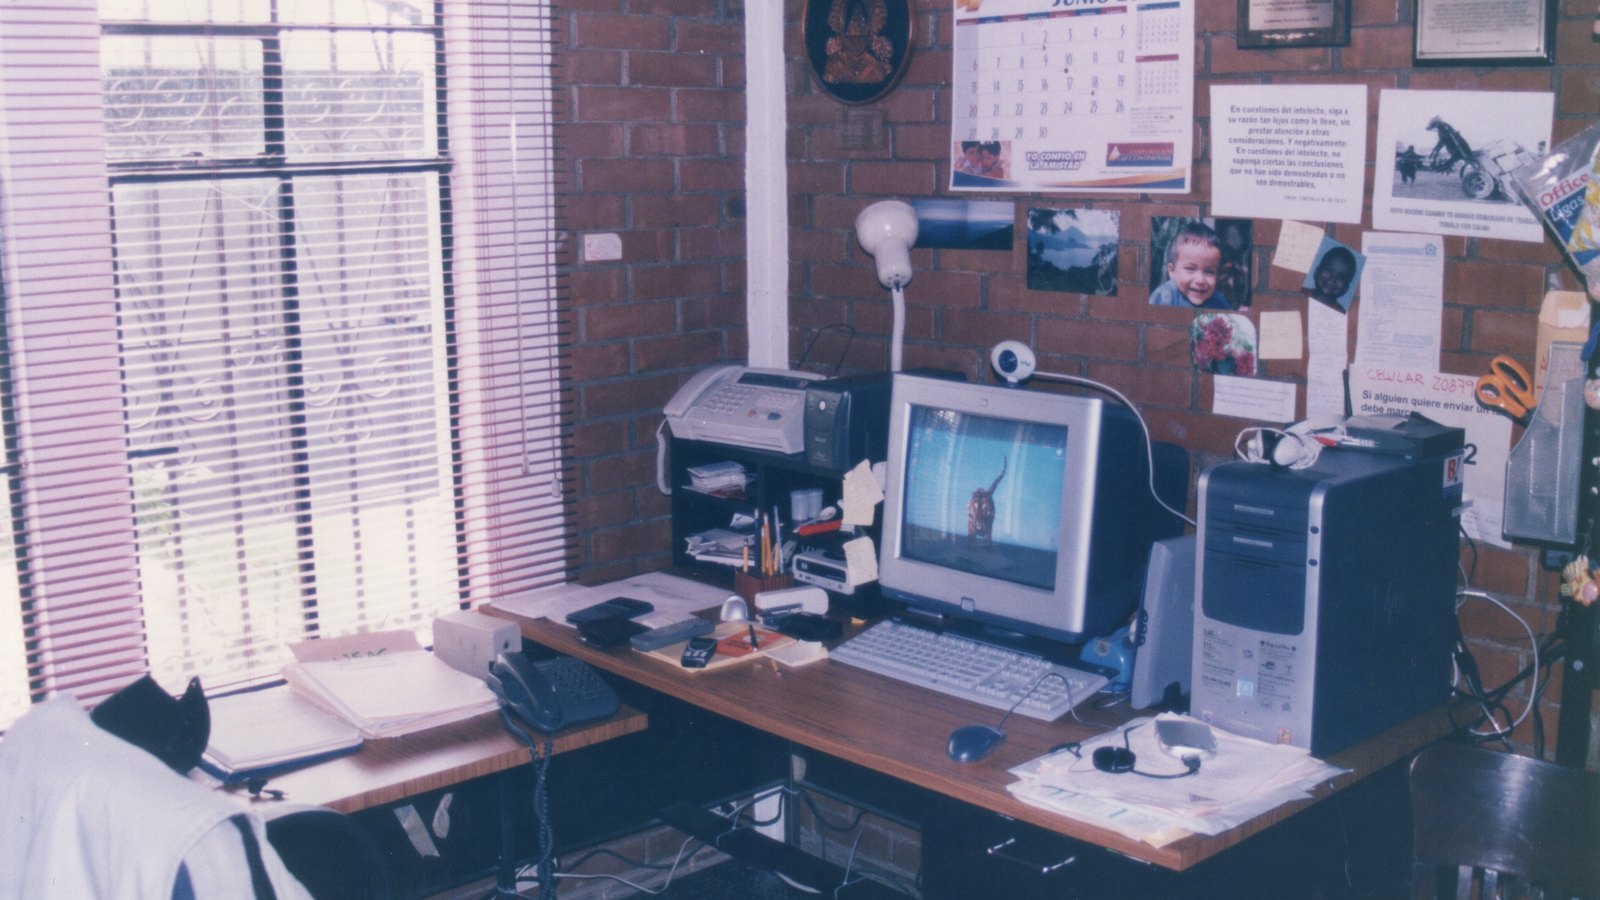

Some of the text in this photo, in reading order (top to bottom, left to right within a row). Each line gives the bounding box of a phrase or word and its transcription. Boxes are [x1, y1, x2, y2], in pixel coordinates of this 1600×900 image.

[1043, 31, 1048, 44] 2
[1068, 28, 1073, 41] 3
[1092, 27, 1098, 40] 4
[1120, 25, 1125, 39] 5
[1043, 54, 1049, 66] 9
[1065, 52, 1073, 66] 10
[1117, 50, 1125, 63] 12
[1066, 76, 1074, 90] 17
[1117, 74, 1125, 87] 19
[969, 104, 978, 118] 20
[1015, 103, 1023, 116] 22
[1040, 102, 1048, 115] 23
[1063, 101, 1073, 114] 24
[1090, 100, 1098, 114] 25
[1115, 99, 1125, 113] 26
[1230, 105, 1241, 113] En
[1242, 106, 1280, 114] cuestiones
[1281, 106, 1292, 114] del
[1328, 107, 1343, 116] siga
[1259, 116, 1271, 124] tan
[1272, 116, 1289, 125] lejos
[1311, 117, 1318, 125] le
[1340, 118, 1351, 126] sin
[968, 127, 977, 140] 27
[1014, 126, 1023, 140] 29
[1038, 126, 1048, 139] 30
[1248, 128, 1273, 136] prestar
[1287, 138, 1293, 146] Y
[1040, 151, 1073, 161] CONFIO
[1074, 151, 1086, 161] EN
[1042, 161, 1081, 171] AMISTAD
[1262, 158, 1285, 166] ciertas
[1286, 159, 1296, 167] las
[1297, 160, 1344, 169] conclusiones
[1229, 168, 1242, 176] que
[1268, 169, 1282, 177] sido
[1283, 170, 1328, 179] demostradas
[1540, 172, 1590, 207] Office
[1549, 195, 1585, 222] Ligas
[1366, 369, 1425, 385] CELULAR
[1362, 390, 1372, 399] Si
[1374, 392, 1409, 405] alguien
[1410, 396, 1441, 409] quiere
[1443, 401, 1474, 413] enviar
[1361, 403, 1384, 413] debe
